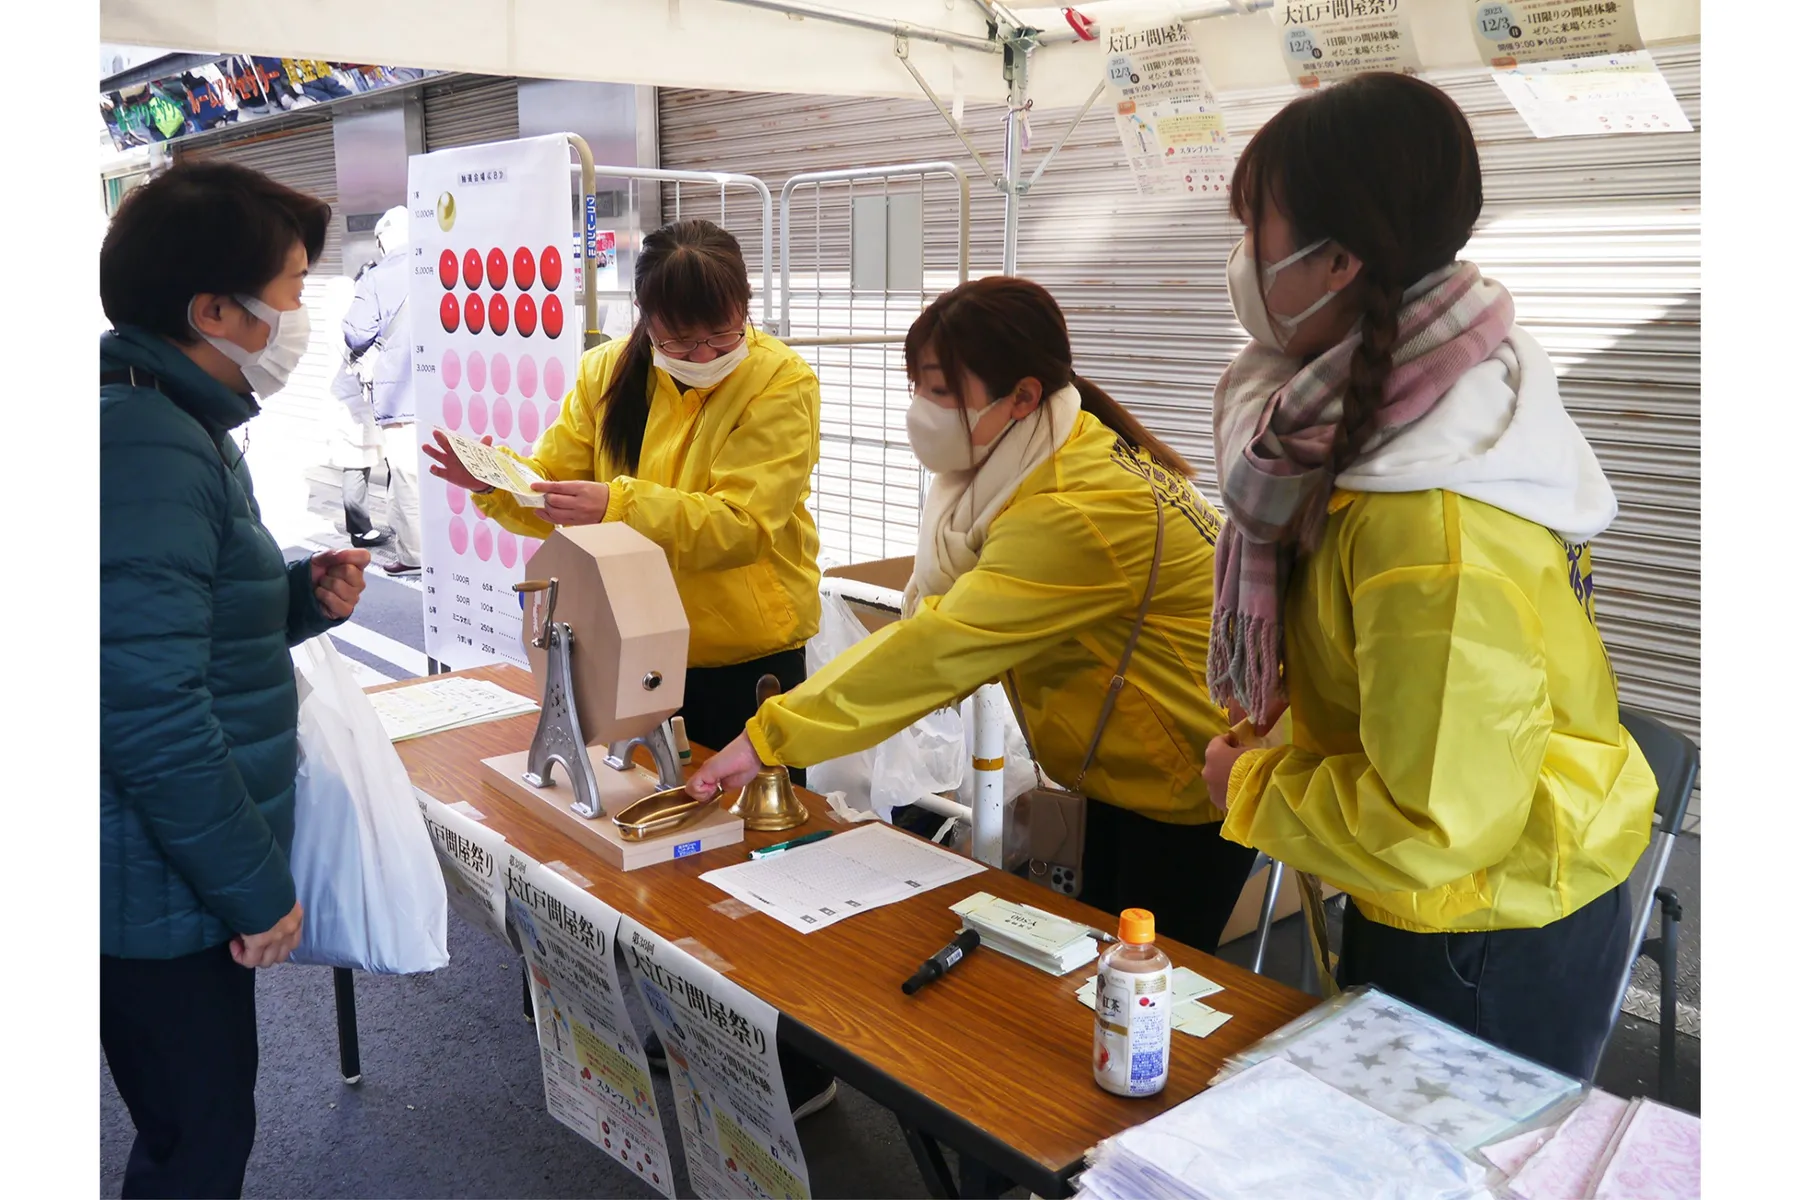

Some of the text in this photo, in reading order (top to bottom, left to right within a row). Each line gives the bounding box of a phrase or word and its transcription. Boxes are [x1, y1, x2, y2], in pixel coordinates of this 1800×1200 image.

[1481, 17, 1511, 33] 12/3
[1533, 18, 1616, 36] ぜひご来場ください
[1289, 40, 1313, 53] 12/3
[1332, 45, 1400, 57] ぜひご来場ください
[1110, 67, 1131, 79] 12/3
[587, 196, 596, 257] ワコーレンタル
[422, 814, 493, 877] 江戸問屋祭り
[504, 868, 605, 956] 大江戸問屋祭り
[631, 946, 766, 1055] 大江戸問屋祭り
[597, 1079, 646, 1119] スタンプラリー
